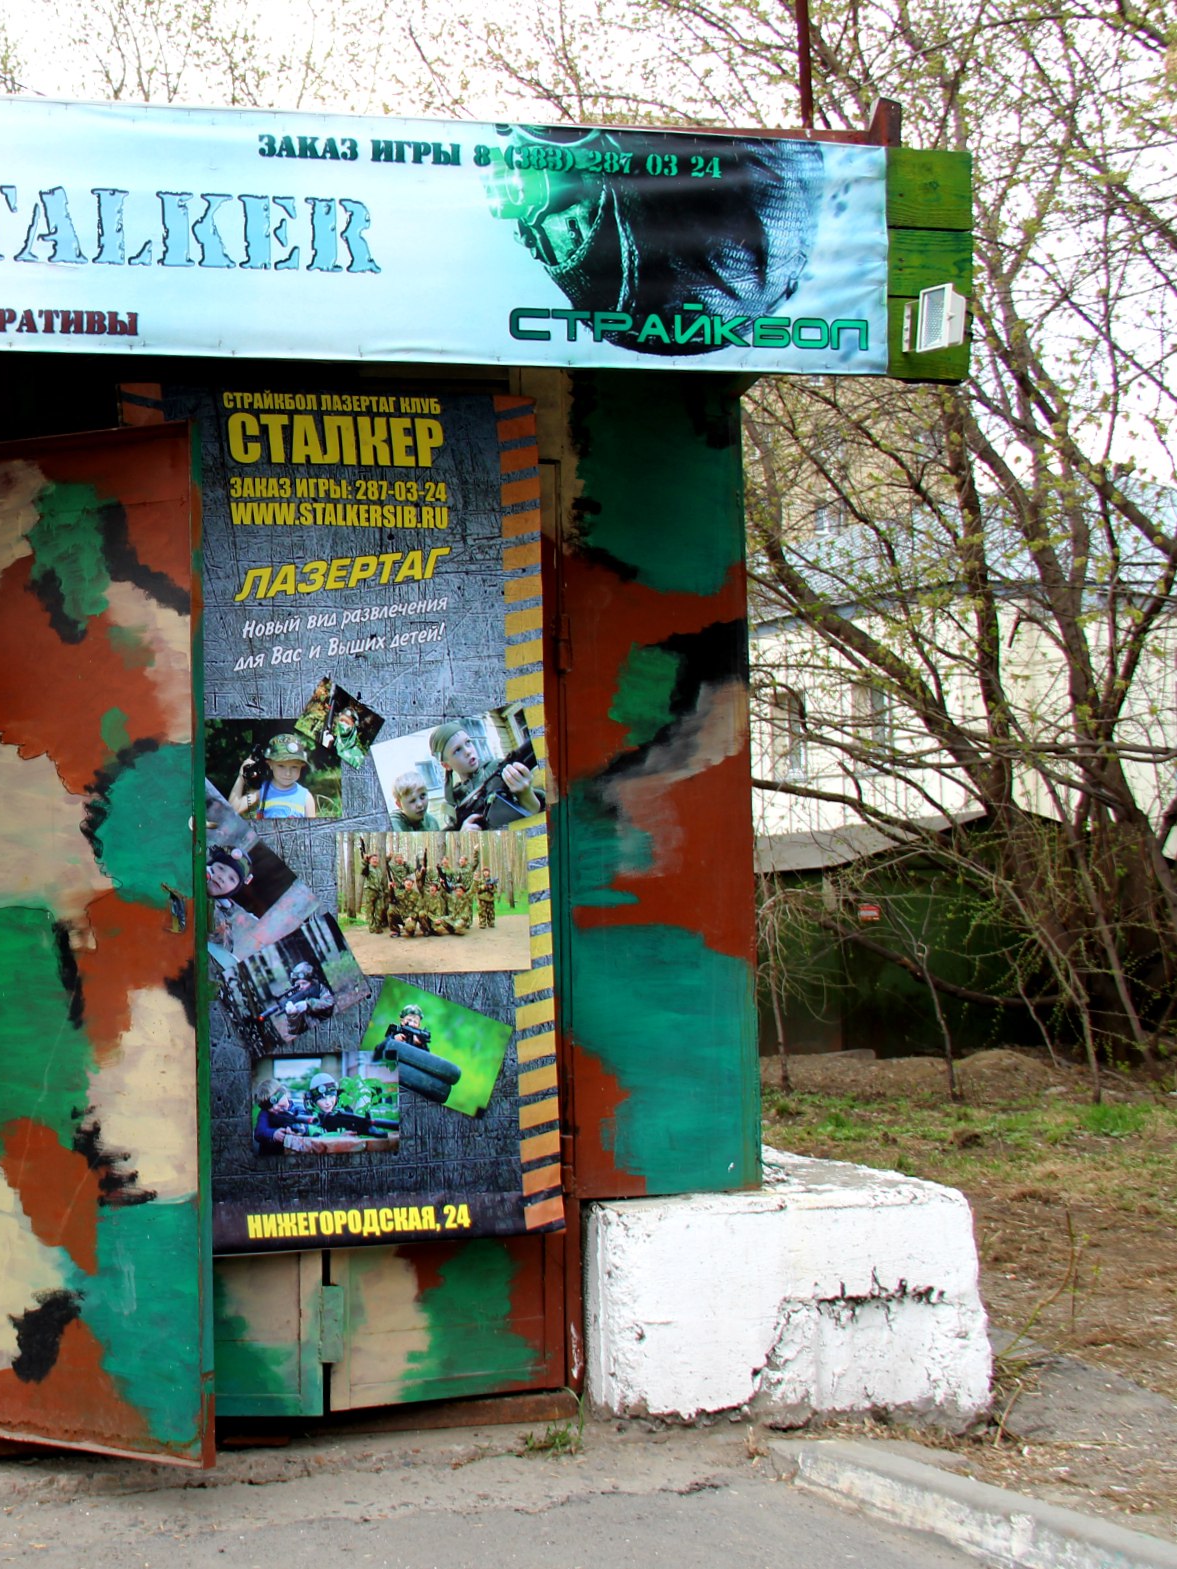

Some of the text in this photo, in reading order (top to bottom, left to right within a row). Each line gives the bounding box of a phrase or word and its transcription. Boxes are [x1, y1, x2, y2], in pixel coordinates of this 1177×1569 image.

[258, 133, 722, 179] ЗАКАЗ ИГРЫ 8 (383) 287 03 24
[223, 389, 442, 415] СТРАЙКБОЛ ЛАЗЕРТАГ КЛУБ
[227, 411, 445, 468] СТАЛКЕР
[229, 476, 448, 502] ЗАКАЗ ИГРЫ: 287-03-24
[230, 501, 449, 530] WWW.STALKERSIB.RU
[234, 547, 452, 603] ЛАЗЕРТАГ
[242, 596, 449, 639] Новый вид развлечения
[233, 652, 265, 672] для
[270, 646, 303, 665] Вас
[308, 644, 322, 659] и
[389, 622, 447, 649] детей!
[246, 1203, 471, 1239] НИЖЕГОРОДСКАЯ, 24
